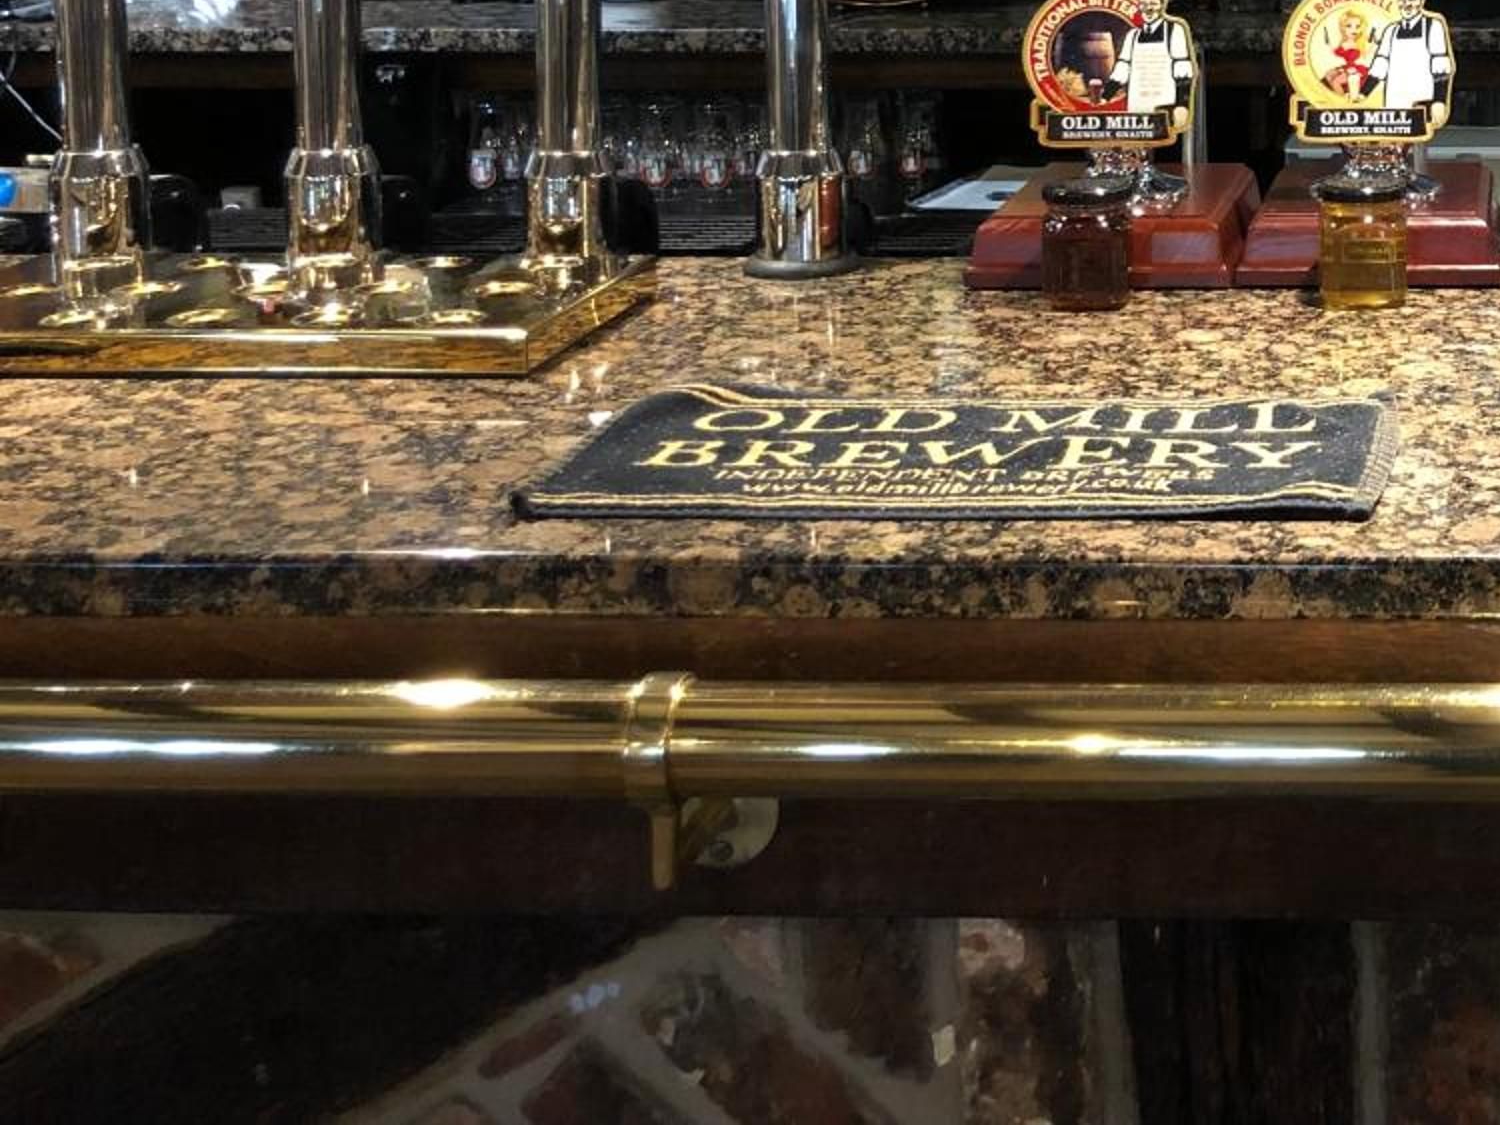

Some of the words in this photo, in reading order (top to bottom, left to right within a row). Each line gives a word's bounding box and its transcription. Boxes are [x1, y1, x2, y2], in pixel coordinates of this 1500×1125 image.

[1294, 12, 1317, 67] BLONDE
[1061, 116, 1100, 130] OLD
[1106, 116, 1154, 130] MILL
[1319, 111, 1358, 125] OLD
[1363, 111, 1412, 125] MILL
[693, 408, 957, 434] OLD
[991, 403, 1317, 434] MILL
[632, 435, 1324, 469] BREWERY
[712, 468, 1008, 483] INDEPENDENT
